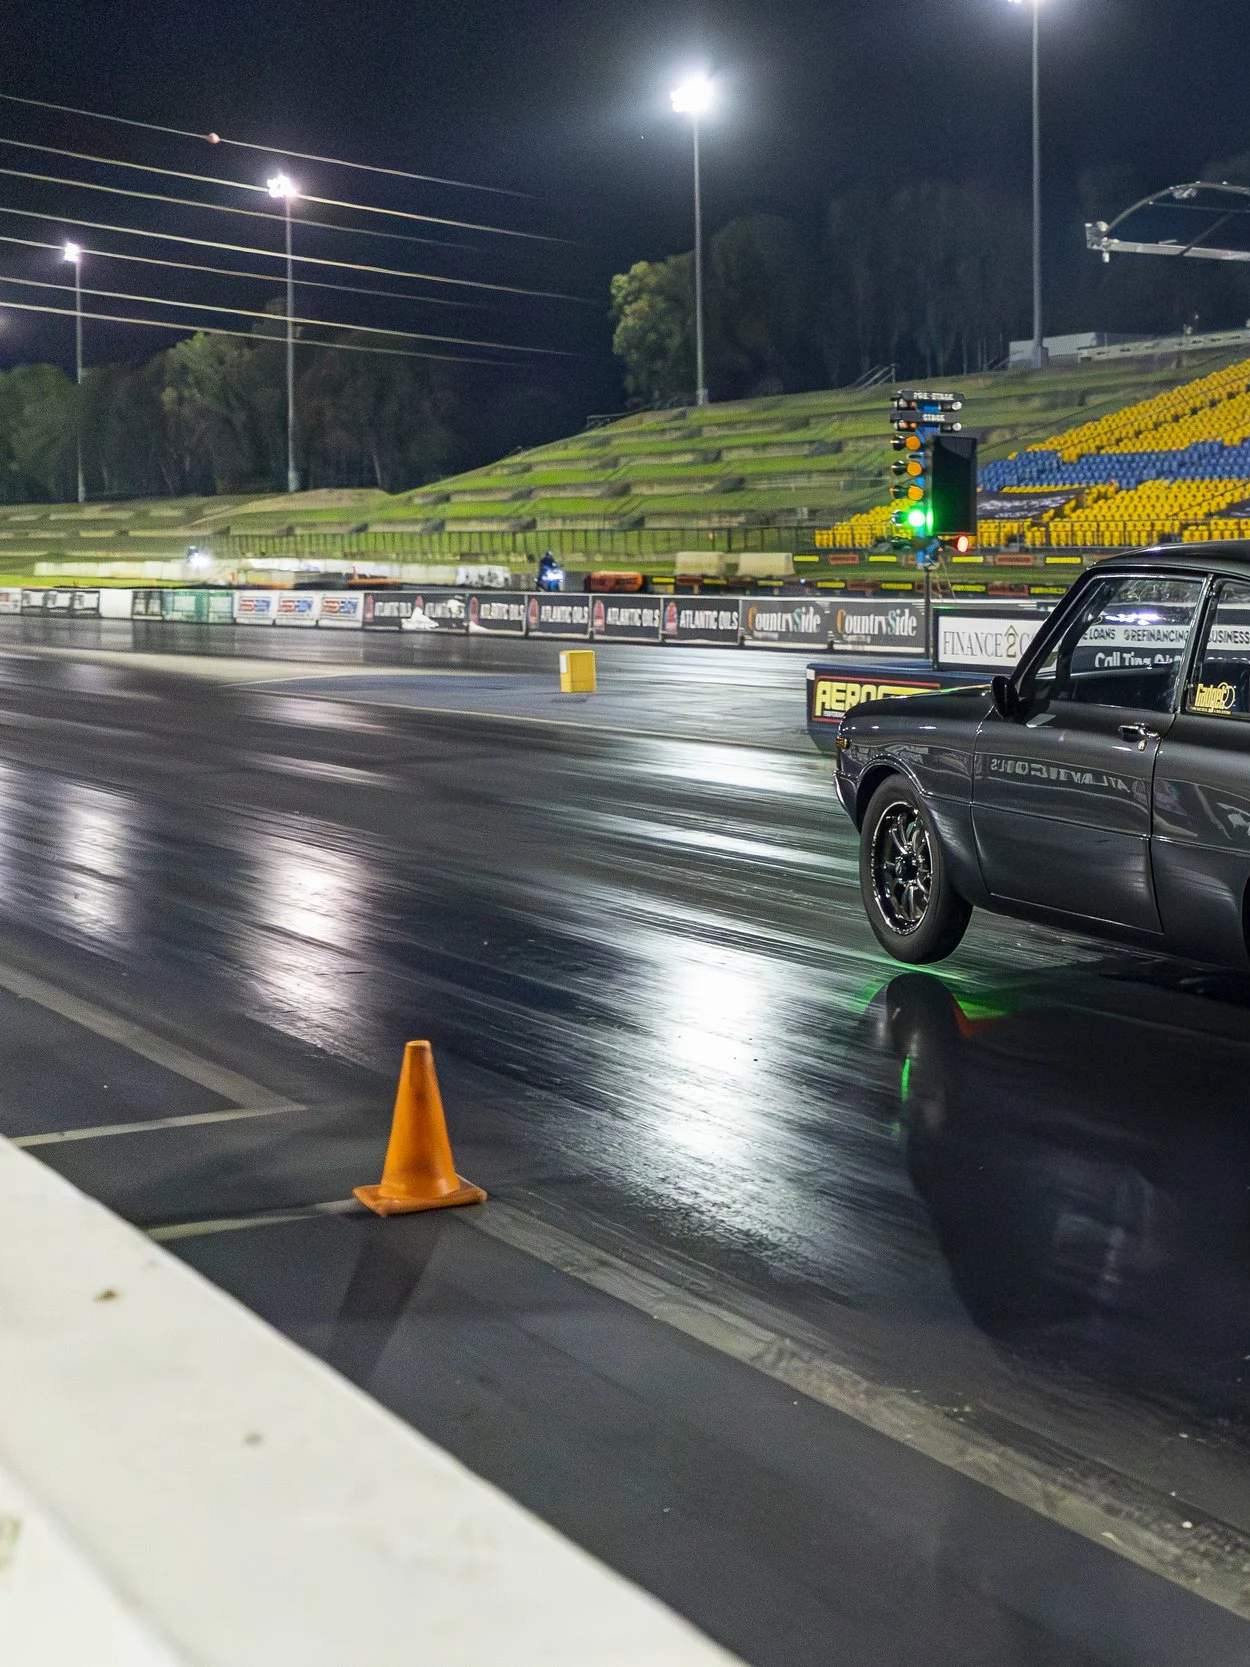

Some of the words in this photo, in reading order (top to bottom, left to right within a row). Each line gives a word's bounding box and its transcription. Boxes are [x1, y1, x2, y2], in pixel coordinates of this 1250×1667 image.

[679, 610, 718, 629] ATLANTIC
[718, 611, 738, 630] OILS
[943, 631, 1003, 657] FINANCE
[1090, 629, 1116, 641] LOANS
[1094, 651, 1121, 667] Call
